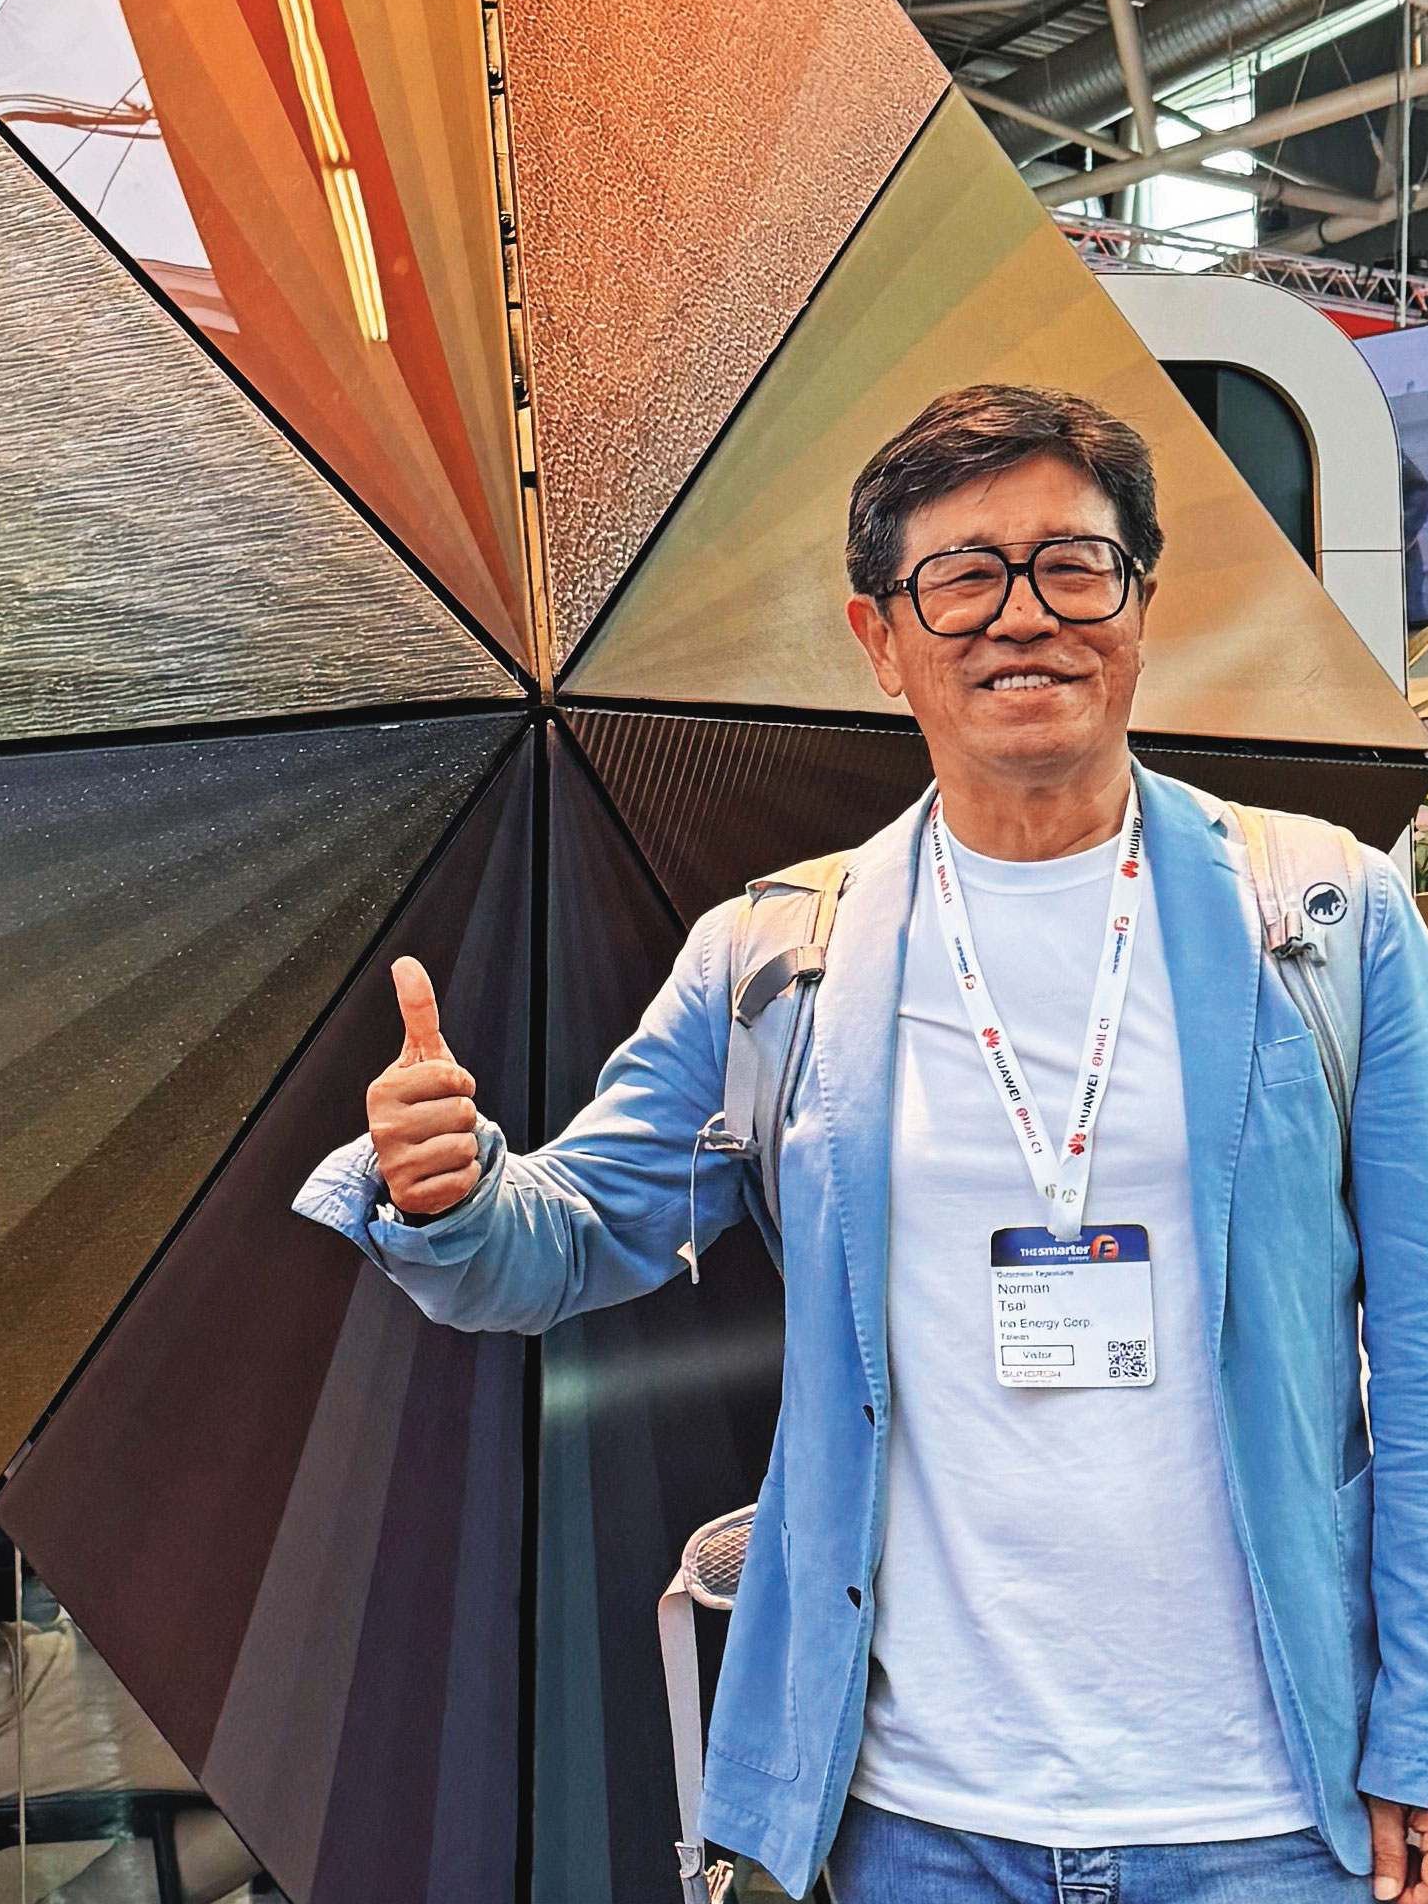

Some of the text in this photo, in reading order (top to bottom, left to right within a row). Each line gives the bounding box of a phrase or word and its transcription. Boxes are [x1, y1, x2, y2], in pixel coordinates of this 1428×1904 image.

[992, 1049, 1021, 1102] HUAWEI
[1077, 1074, 1099, 1129] HUAWEI
[997, 1283, 1051, 1296] Norman
[999, 1300, 1027, 1312] Tsai
